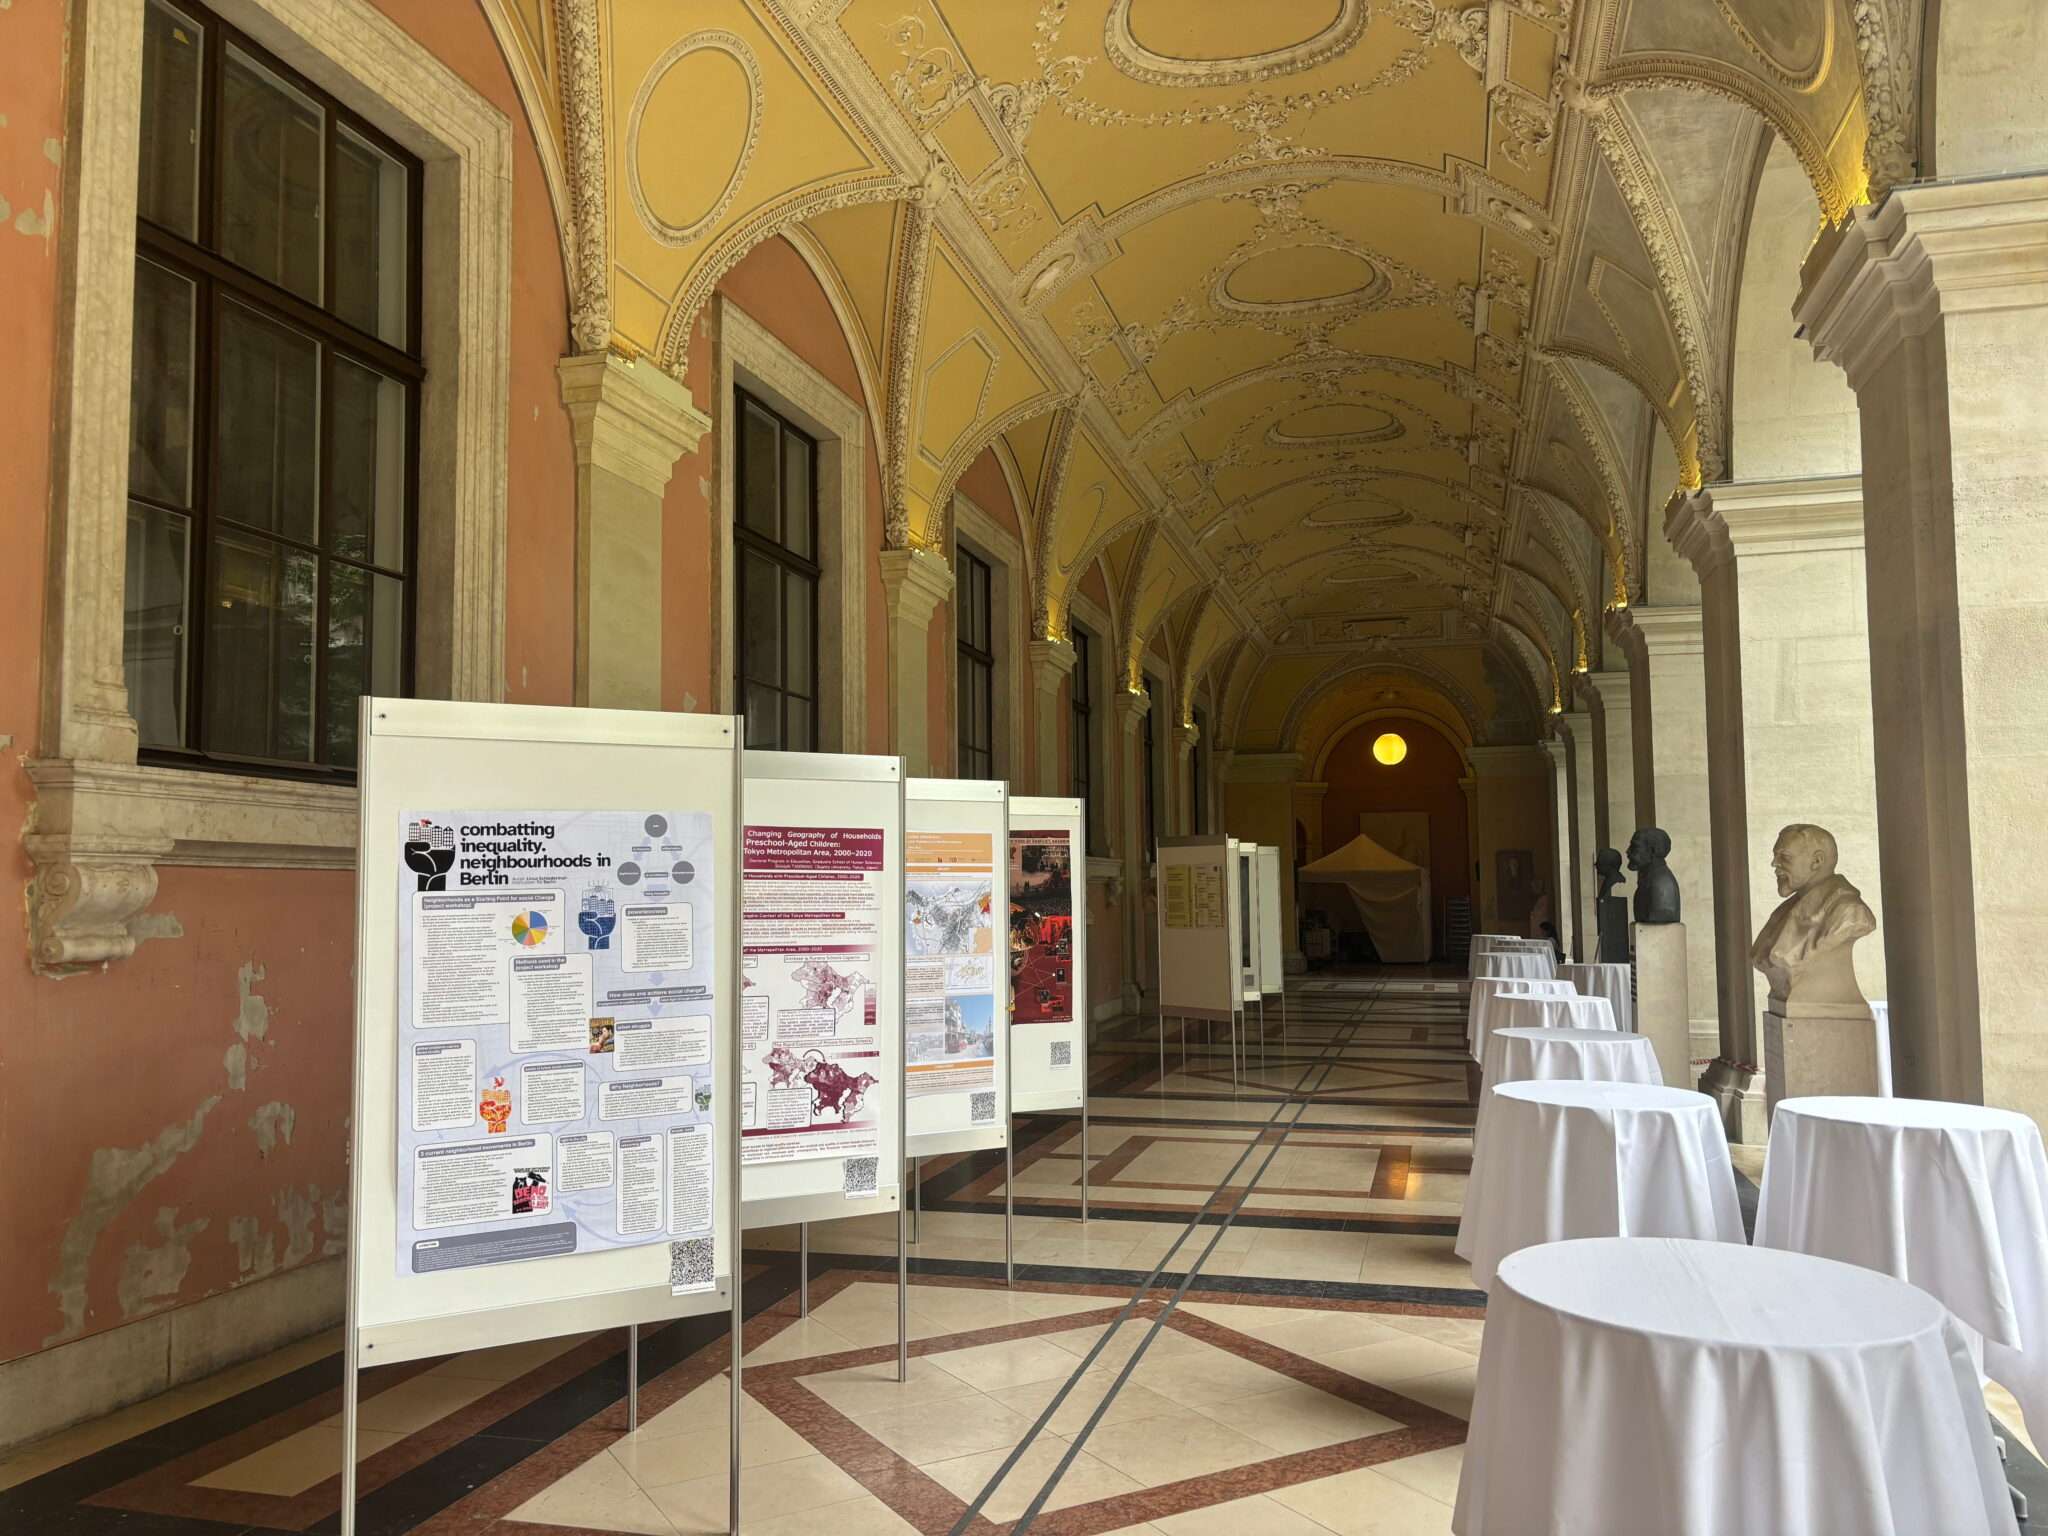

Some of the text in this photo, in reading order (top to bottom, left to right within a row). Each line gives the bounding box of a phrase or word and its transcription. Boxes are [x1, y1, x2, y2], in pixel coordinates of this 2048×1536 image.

[460, 821, 555, 839] combatting
[747, 830, 782, 839] Changing
[787, 831, 825, 840] Geography
[843, 832, 881, 840] Households
[460, 837, 546, 855] inequality.
[746, 839, 840, 848] Preschool-Aged Children:
[743, 848, 765, 856] Tokyo
[767, 848, 812, 857] Metropolitan
[813, 849, 832, 857] Area,
[460, 852, 611, 872] neighbourhoods in
[460, 870, 509, 885] Berlin
